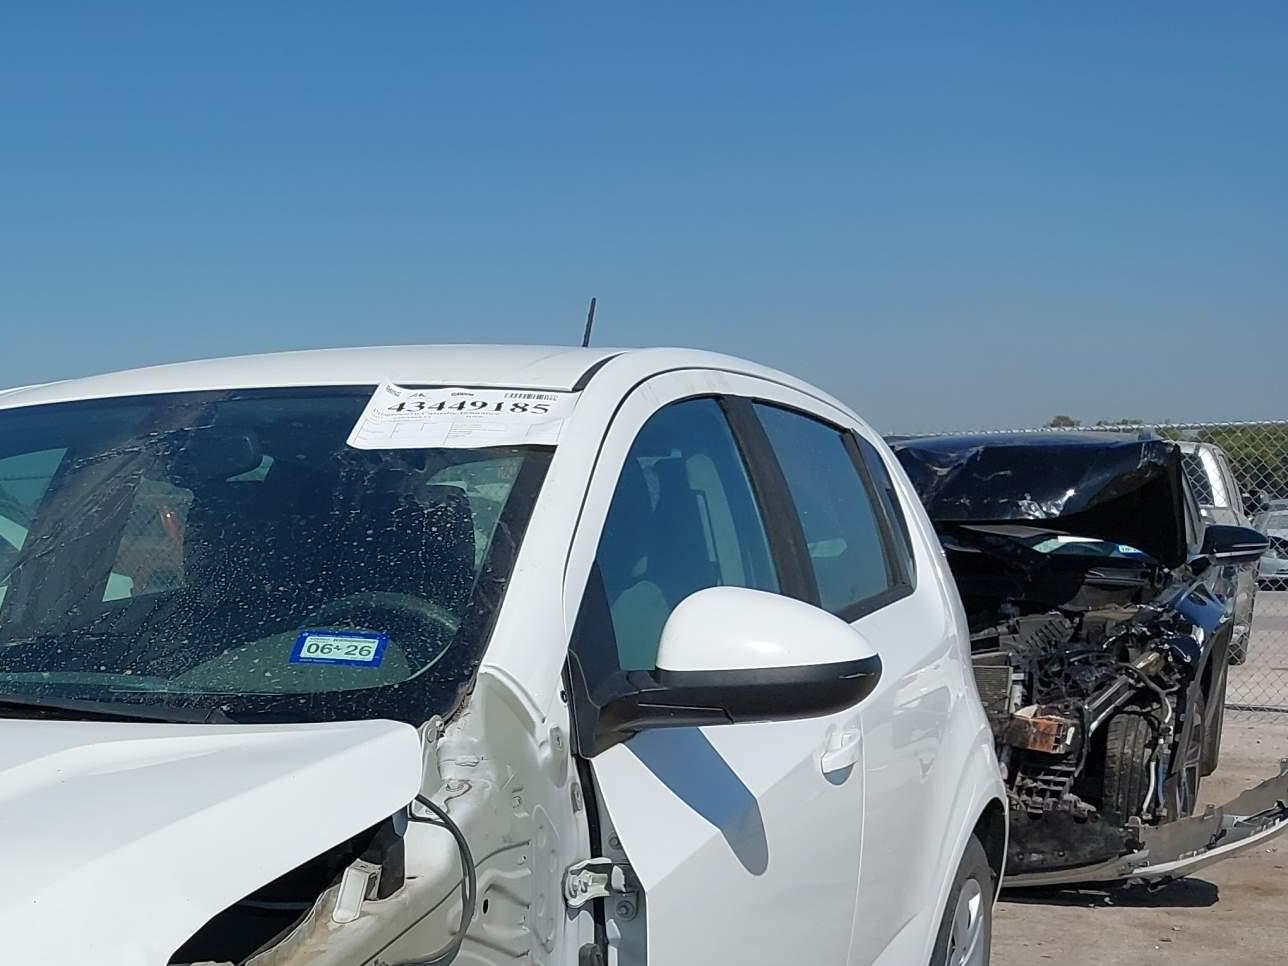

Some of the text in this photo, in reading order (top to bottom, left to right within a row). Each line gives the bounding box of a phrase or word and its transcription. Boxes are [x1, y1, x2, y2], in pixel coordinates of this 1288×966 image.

[387, 400, 552, 415] 43449185
[306, 643, 372, 657] 06 26
